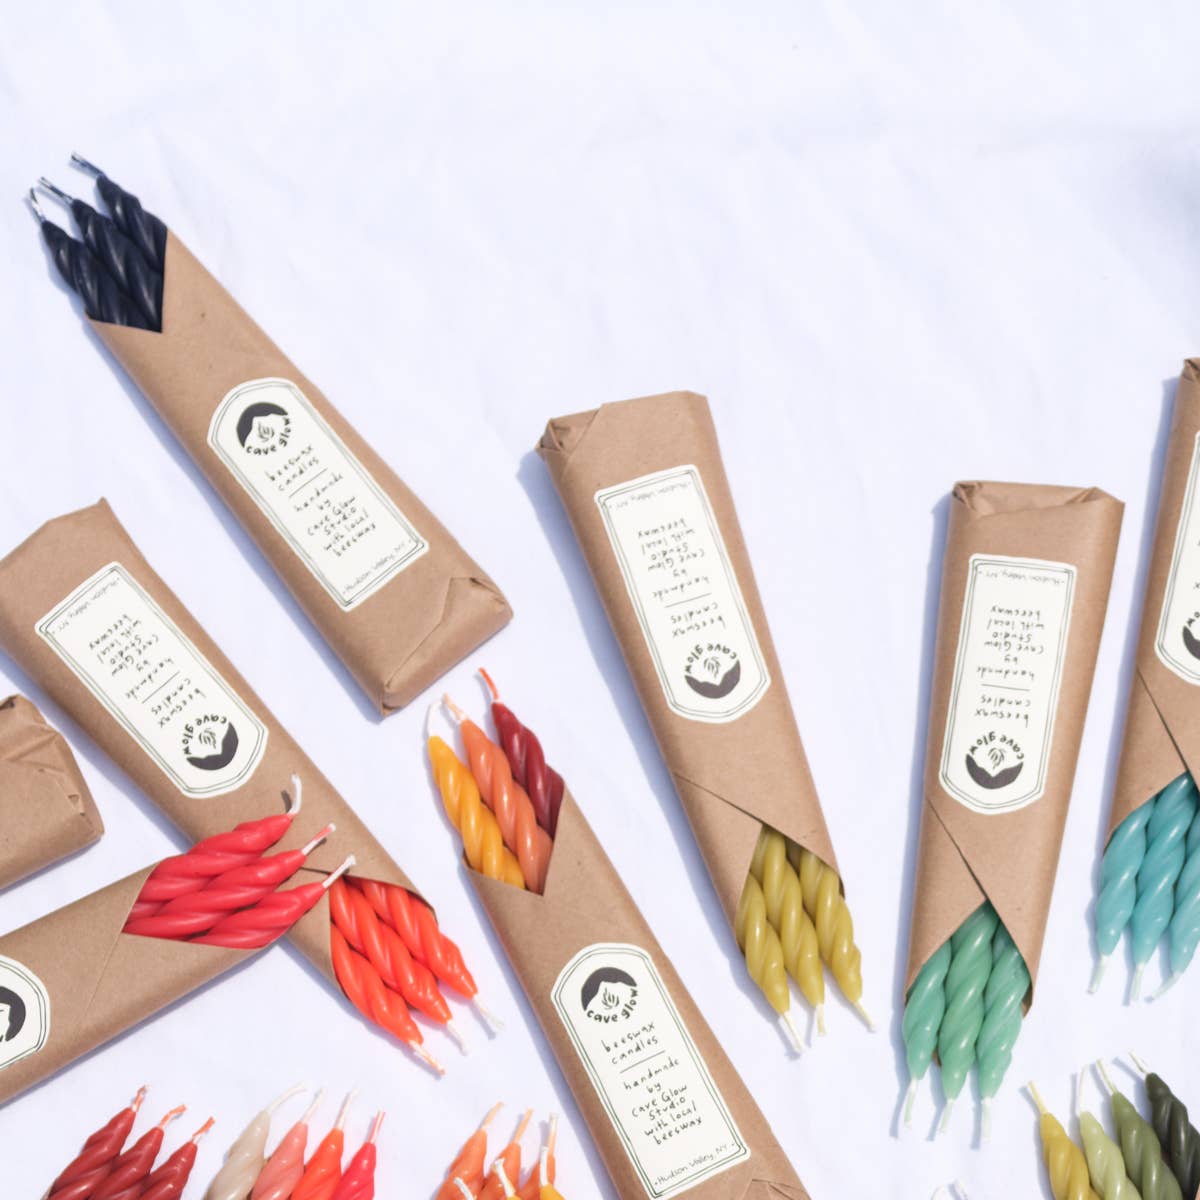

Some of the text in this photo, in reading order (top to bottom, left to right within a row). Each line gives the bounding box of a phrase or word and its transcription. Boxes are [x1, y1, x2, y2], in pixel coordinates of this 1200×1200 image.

[669, 601, 719, 624] candles
[671, 614, 727, 639] beeswax
[585, 984, 638, 1024] cave glow
[600, 1020, 655, 1053] beeswax
[611, 1035, 658, 1065] candles
